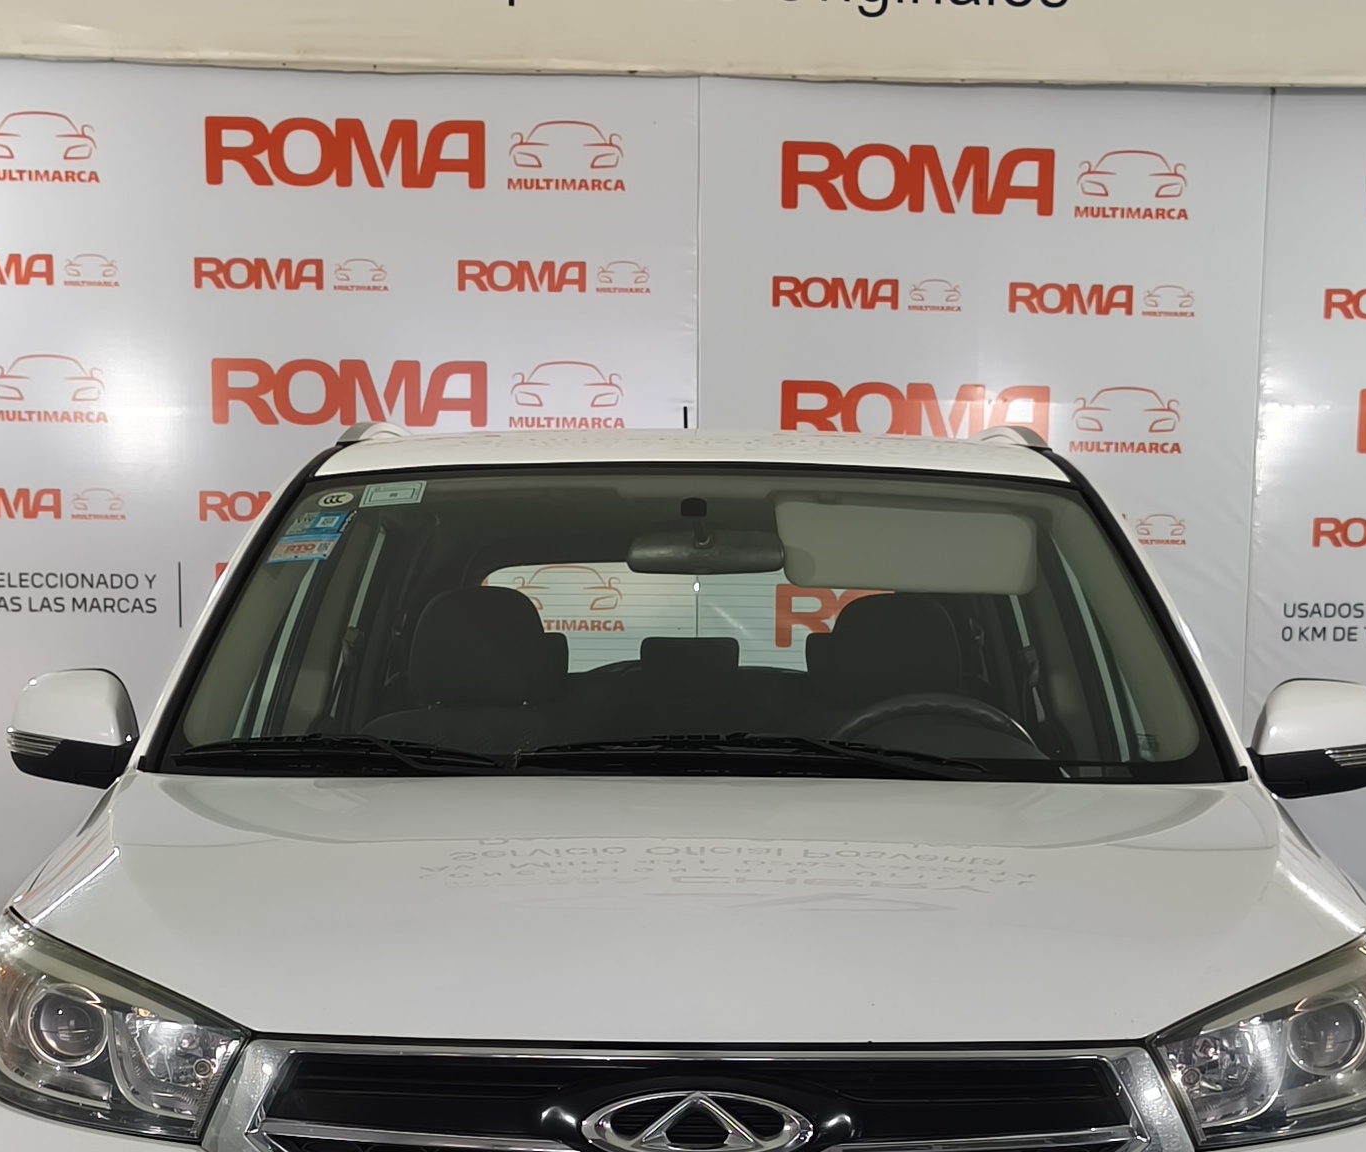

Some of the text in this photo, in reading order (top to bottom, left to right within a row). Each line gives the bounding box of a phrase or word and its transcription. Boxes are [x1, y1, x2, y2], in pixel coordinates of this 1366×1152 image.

[204, 116, 486, 189] ROMA
[508, 178, 625, 191] MULTIMARCA
[781, 141, 1056, 217] ROMA
[1075, 206, 1188, 220] MULTIMARCA
[194, 257, 324, 290] ROMA
[457, 260, 587, 293] ROMA
[772, 275, 900, 310] ROMA
[1009, 281, 1134, 316] ROMA
[211, 357, 487, 427] ROMA
[508, 416, 625, 429] MULTIMARCA
[780, 380, 1051, 444] ROMA
[1071, 442, 1181, 454] MULTIMARCA
[199, 491, 272, 522] RO
[145, 574, 156, 589] Y
[29, 597, 65, 612] LAS
[72, 597, 157, 613] MARCAS
[1284, 603, 1364, 618] USADOS
[544, 619, 625, 631] TIMARCA
[1282, 626, 1293, 642] 0
[1299, 627, 1326, 641] KM
[1333, 627, 1358, 641] DE
